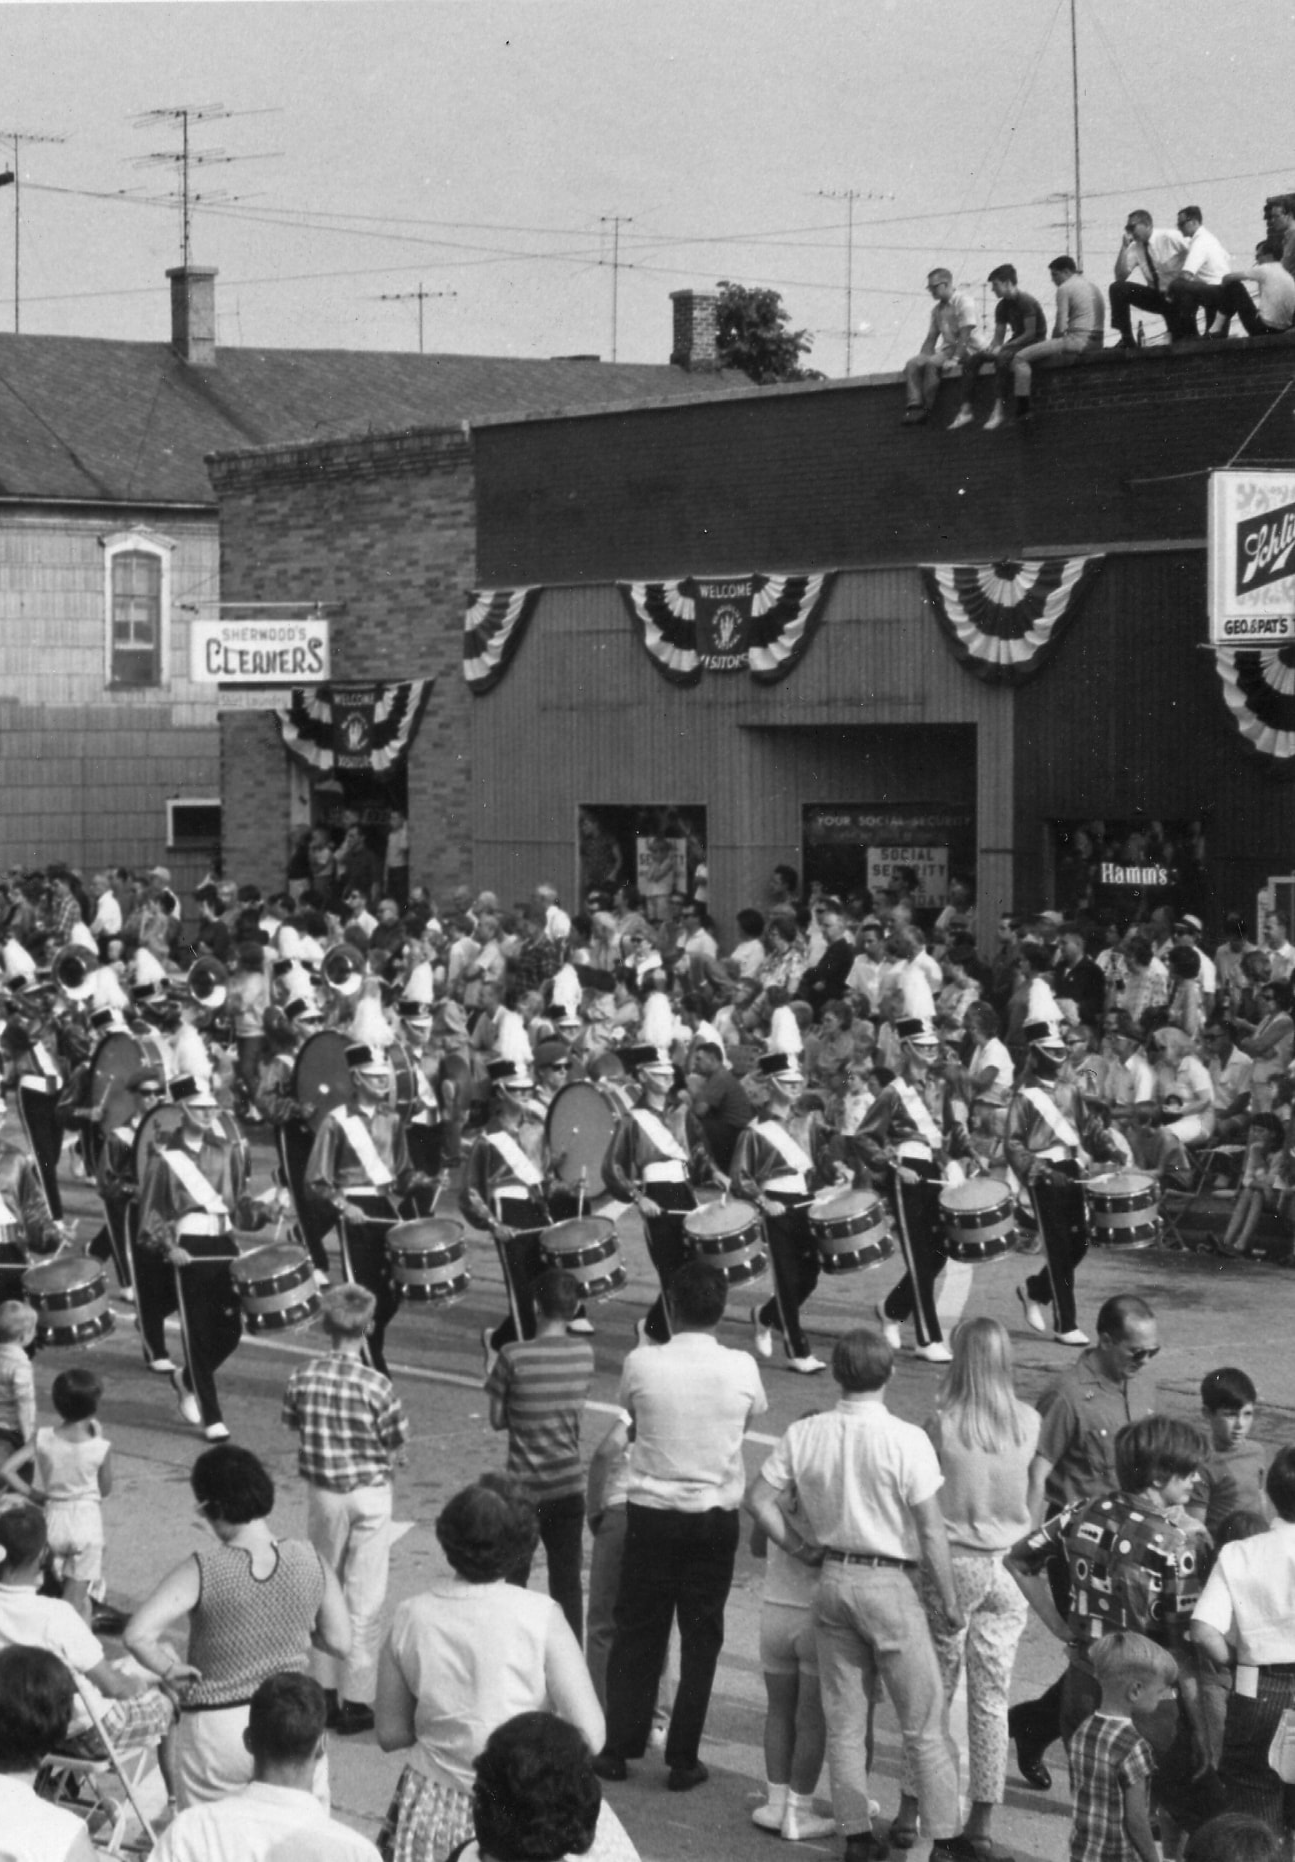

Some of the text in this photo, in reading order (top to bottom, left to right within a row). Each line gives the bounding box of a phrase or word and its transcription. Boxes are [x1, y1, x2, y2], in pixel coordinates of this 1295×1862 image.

[1242, 513, 1295, 584] Schli
[699, 582, 753, 599] WELCOME
[221, 626, 307, 641] SHERWOOD'S
[205, 637, 324, 675] CLEANERS
[816, 815, 851, 827] YOUR
[858, 815, 904, 827] SOCIAL
[879, 848, 934, 862] SOCIAL
[1101, 861, 1168, 885] Hamm's
